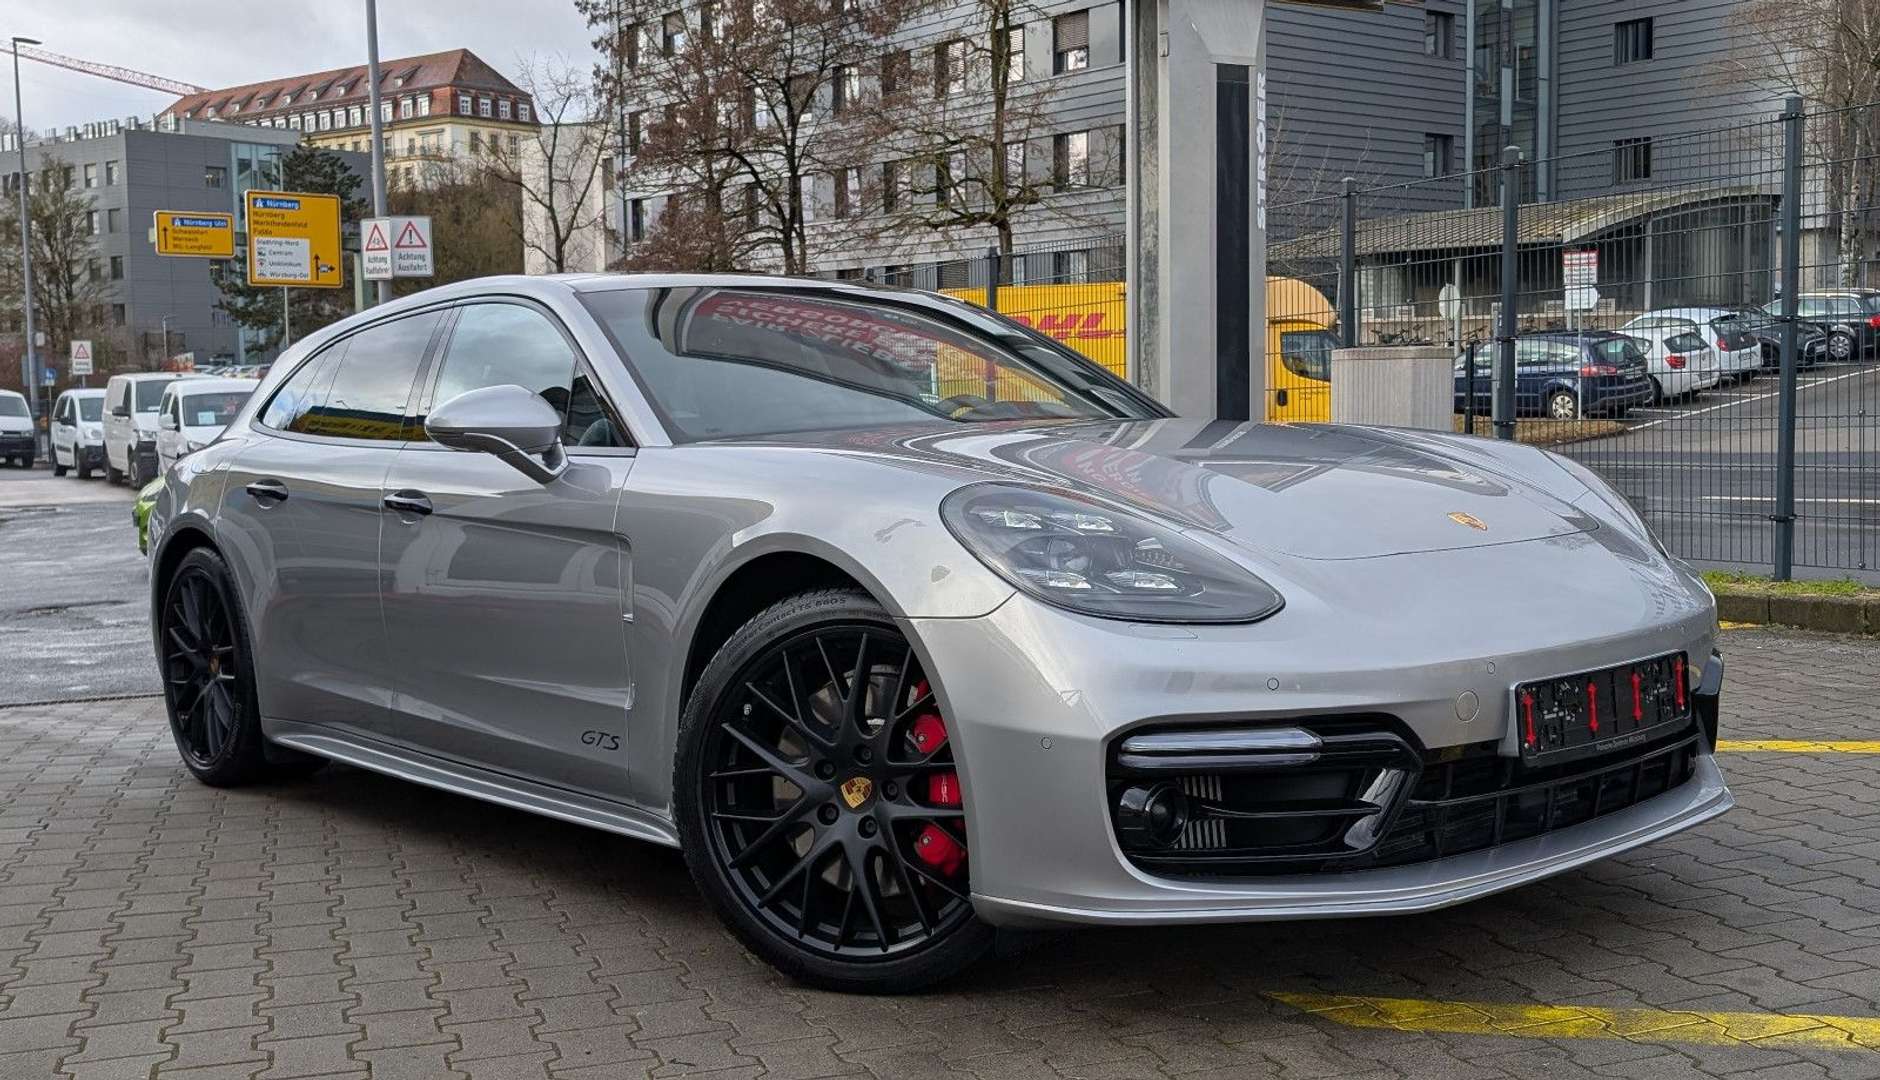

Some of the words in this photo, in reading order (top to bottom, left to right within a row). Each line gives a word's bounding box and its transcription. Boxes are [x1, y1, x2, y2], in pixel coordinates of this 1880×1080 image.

[266, 200, 299, 210] Nürnberg
[183, 219, 213, 228] Nürnberg
[398, 252, 426, 262] Achtung
[398, 263, 428, 272] Ausfahrt
[581, 730, 621, 751] GTS
